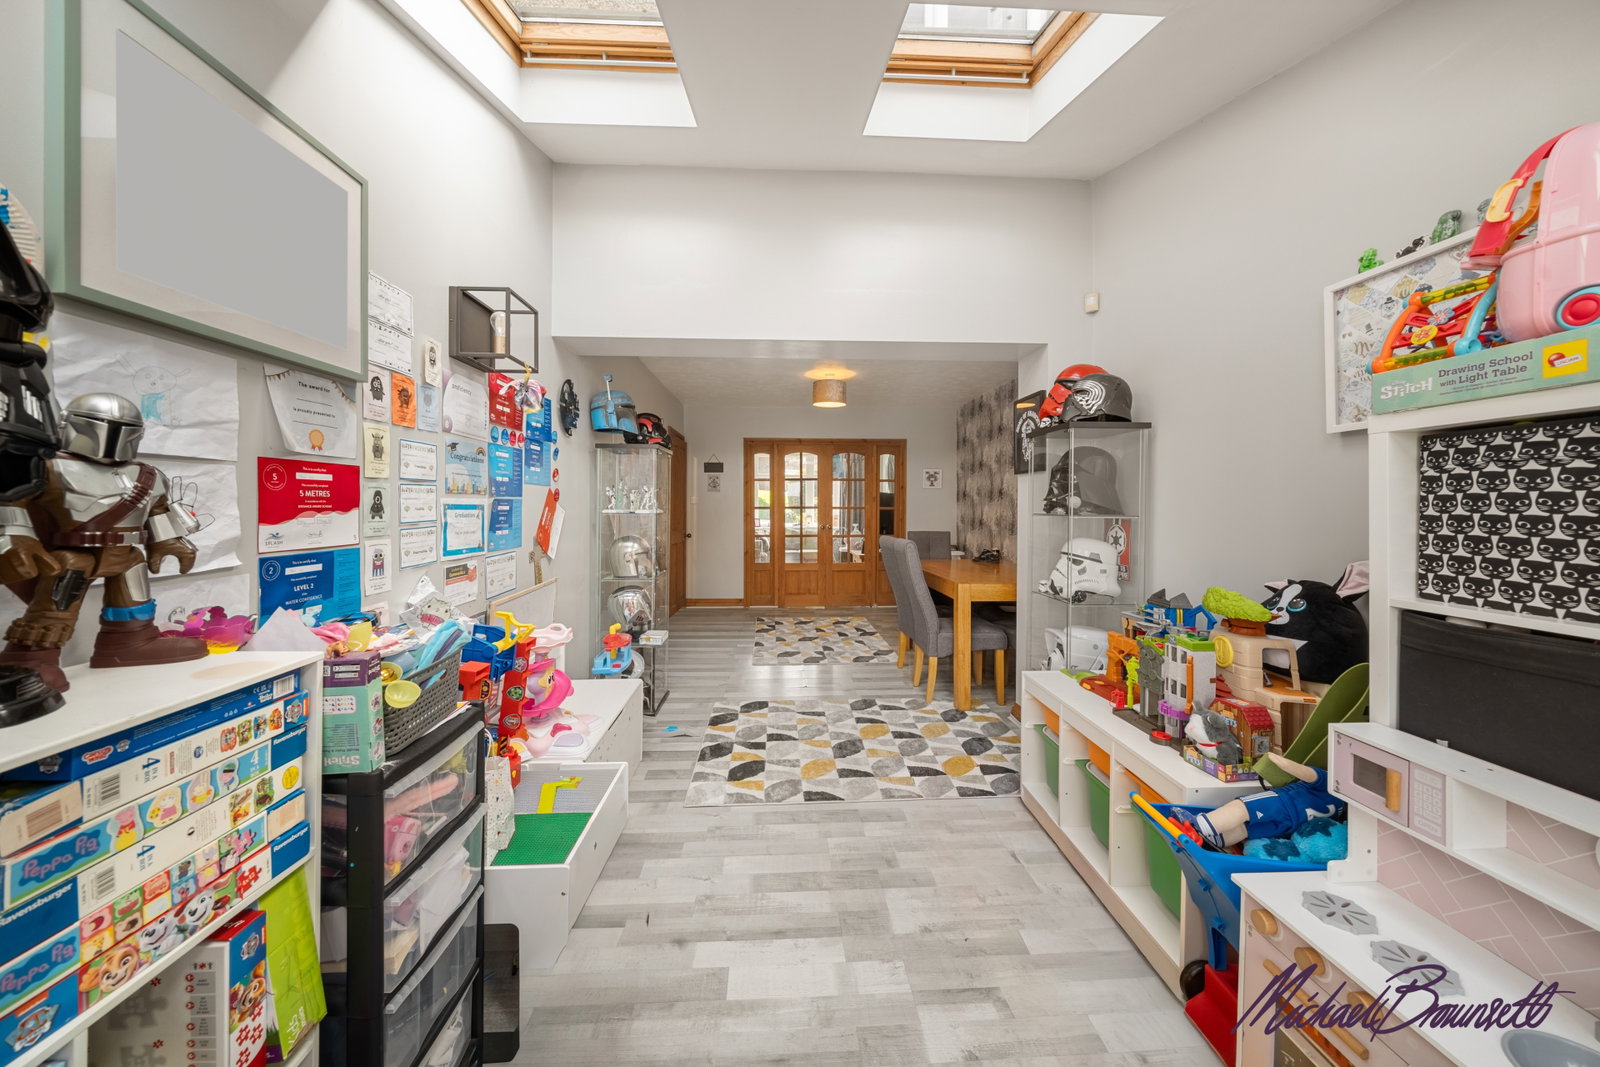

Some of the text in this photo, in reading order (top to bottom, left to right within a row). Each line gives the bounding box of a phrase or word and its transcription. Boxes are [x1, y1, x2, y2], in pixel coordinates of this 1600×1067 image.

[1438, 351, 1533, 378] Drawing School
[1440, 379, 1456, 387] with
[1458, 371, 1488, 384] Light
[1491, 365, 1527, 378] Table
[273, 726, 307, 745] Ravensburger
[142, 757, 160, 770] 4
[251, 750, 259, 764] 4
[273, 826, 309, 853] Ravensburger
[23, 835, 99, 879] Peppa Pig
[137, 845, 155, 858] 4
[1, 943, 75, 993] Peppa Pig
